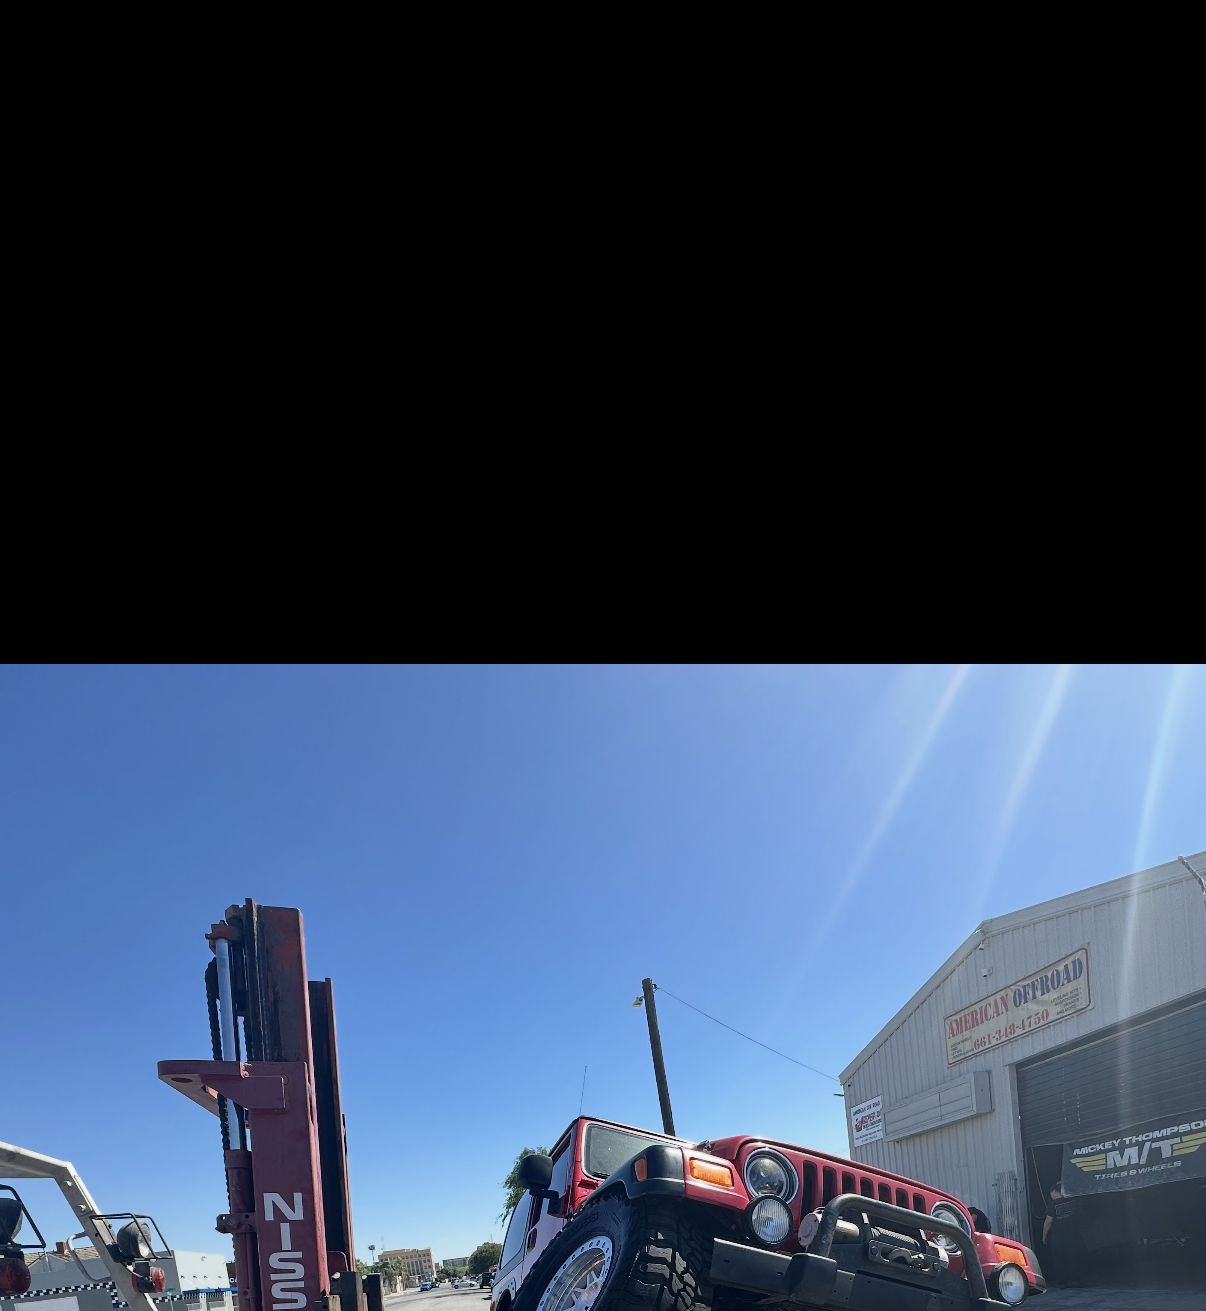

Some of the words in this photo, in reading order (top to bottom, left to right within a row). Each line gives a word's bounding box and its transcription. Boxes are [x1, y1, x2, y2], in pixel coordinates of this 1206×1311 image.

[948, 993, 1009, 1039] AMERICAN
[1013, 957, 1083, 1008] OFFROAD
[974, 1008, 1050, 1050] 661-348-4750
[1073, 1139, 1121, 1155] MICKEY
[1123, 1119, 1206, 1145] THOMPSO
[1106, 1137, 1181, 1169] M/T
[1094, 1170, 1128, 1180] TIRES
[1137, 1160, 1182, 1174] WHEELS
